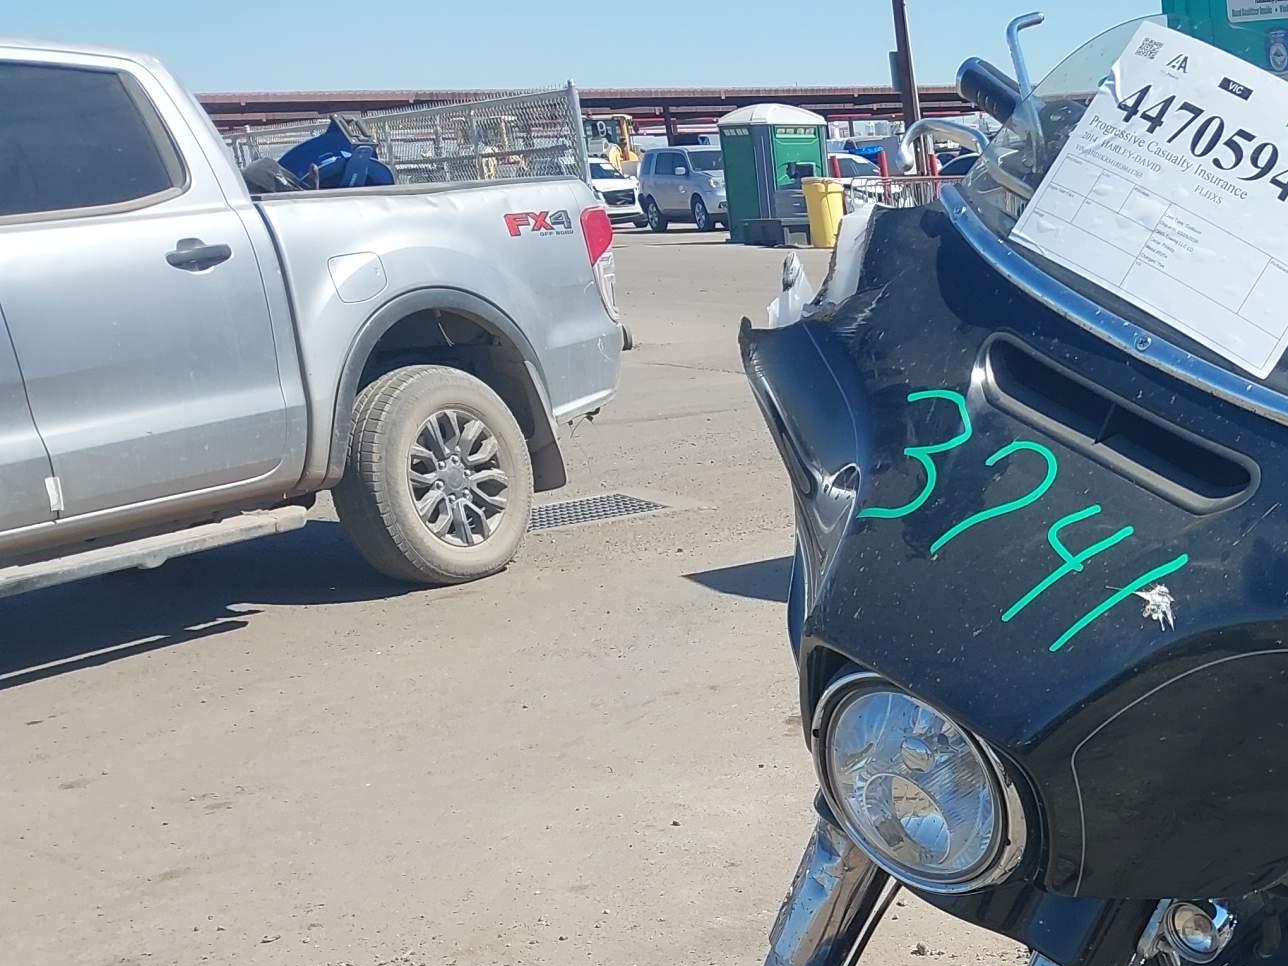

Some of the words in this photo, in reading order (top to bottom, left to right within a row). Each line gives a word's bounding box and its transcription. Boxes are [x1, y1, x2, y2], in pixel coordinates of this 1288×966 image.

[1227, 81, 1244, 95] VIC
[1089, 115, 1146, 148] Progressive
[1146, 140, 1194, 173] Casualty
[1194, 163, 1249, 201] Insurance
[1101, 140, 1161, 173] HARLEY-DAVID
[504, 210, 572, 237] FX4
